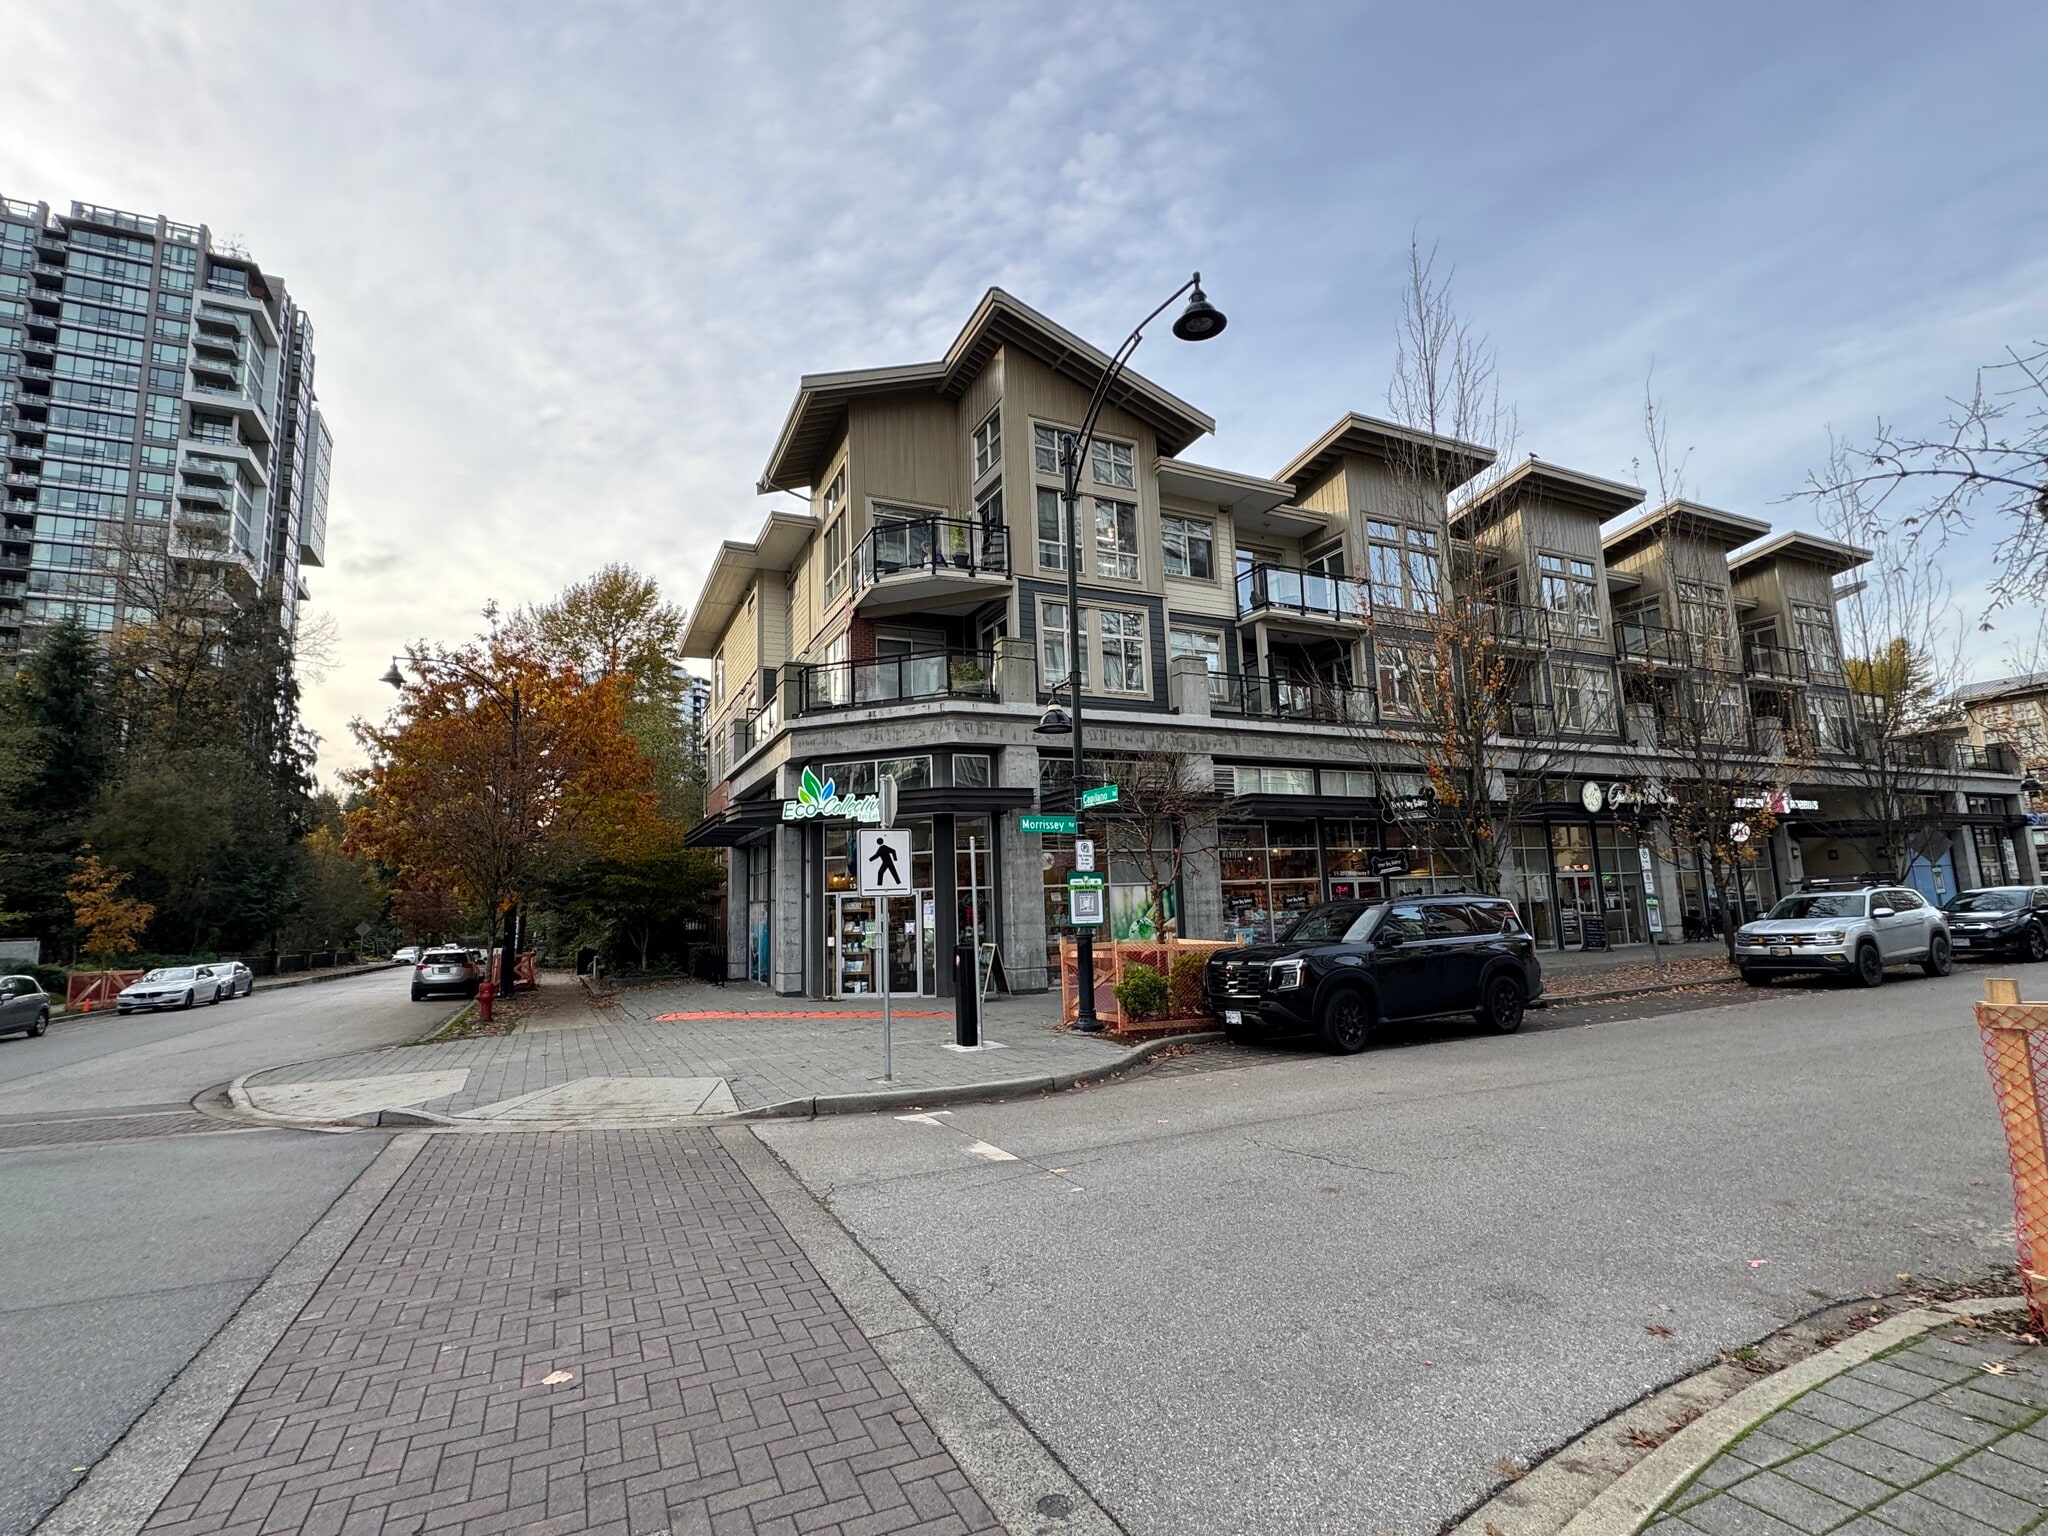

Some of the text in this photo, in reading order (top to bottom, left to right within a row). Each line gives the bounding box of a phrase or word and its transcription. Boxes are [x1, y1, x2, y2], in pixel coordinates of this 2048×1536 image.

[1082, 792, 1108, 805] Capilano
[782, 794, 880, 820] Eco-Collectiv
[1022, 819, 1065, 832] Morrissey
